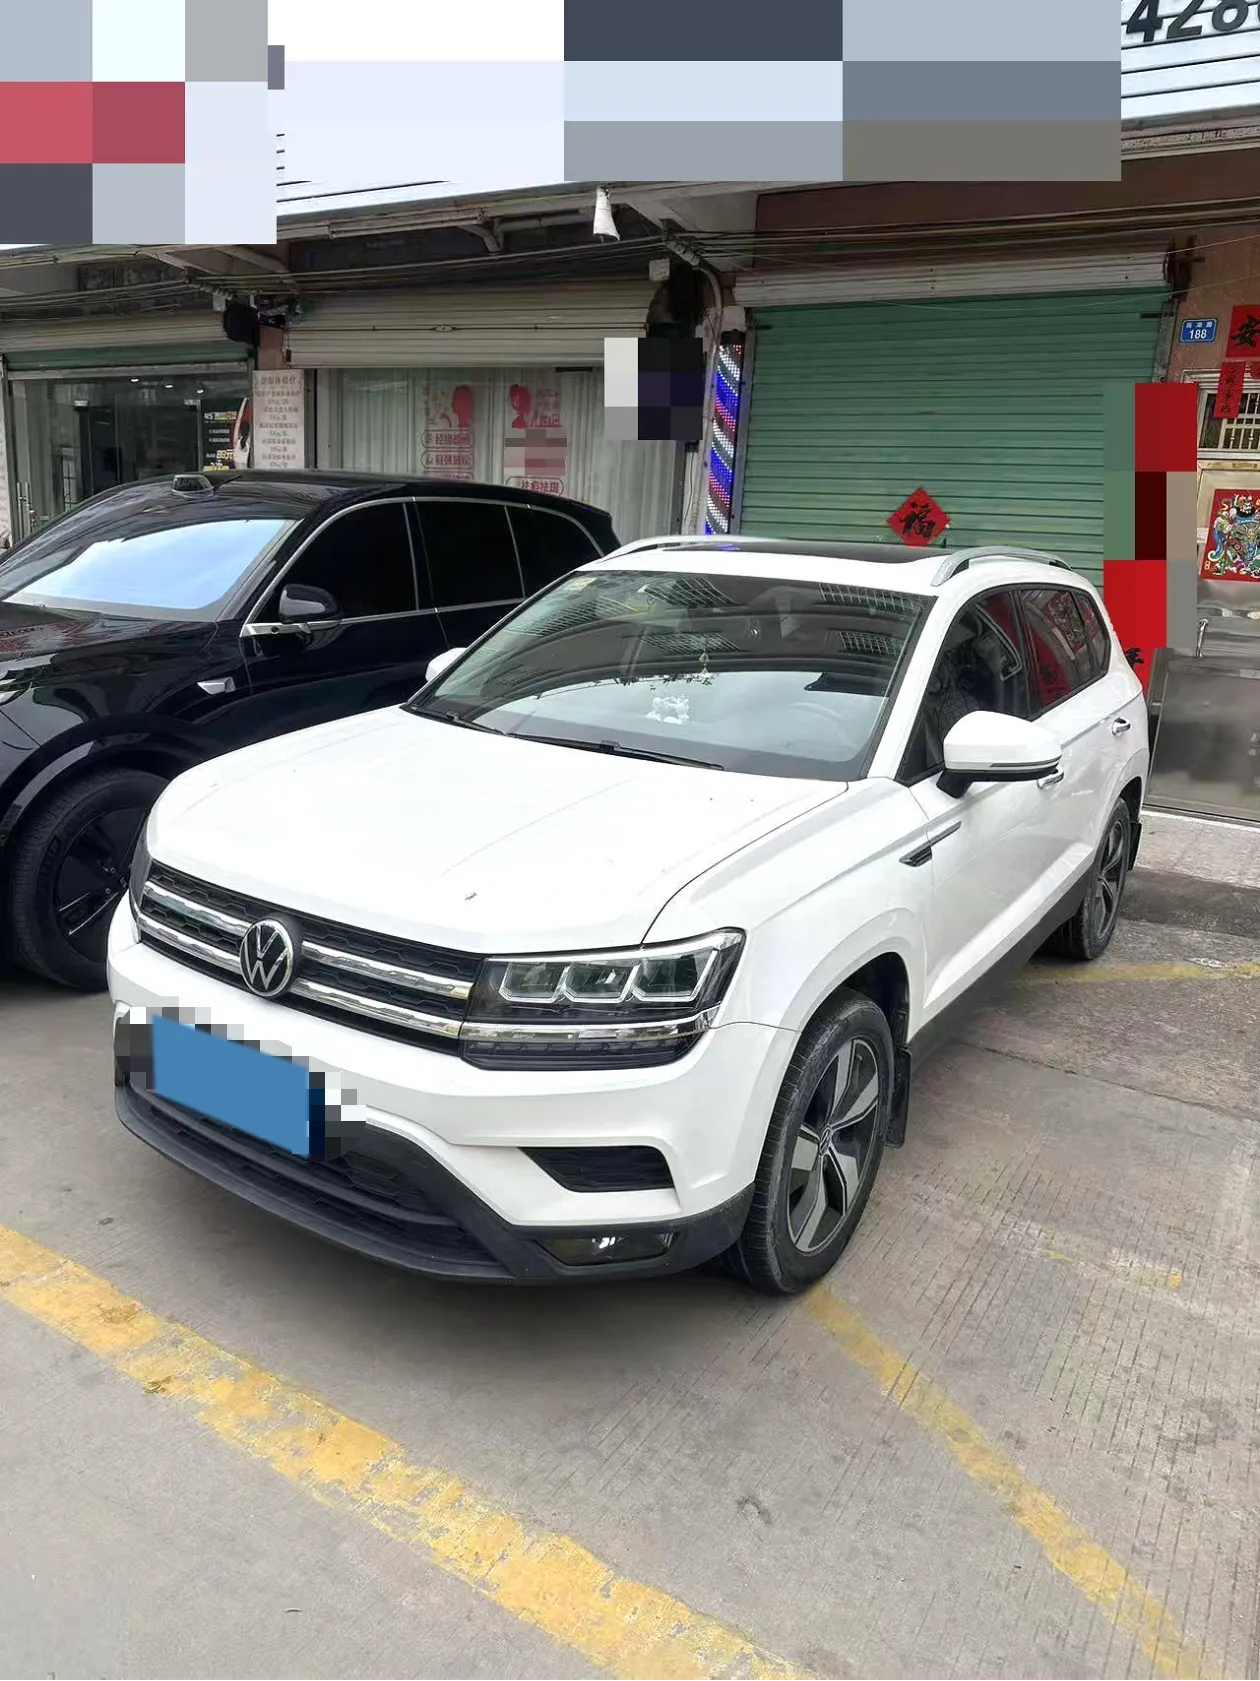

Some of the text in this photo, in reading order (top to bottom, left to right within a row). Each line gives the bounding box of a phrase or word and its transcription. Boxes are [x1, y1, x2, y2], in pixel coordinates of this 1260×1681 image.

[1189, 329, 1207, 340] 188
[1231, 315, 1260, 348] 安
[899, 501, 936, 538] 福
